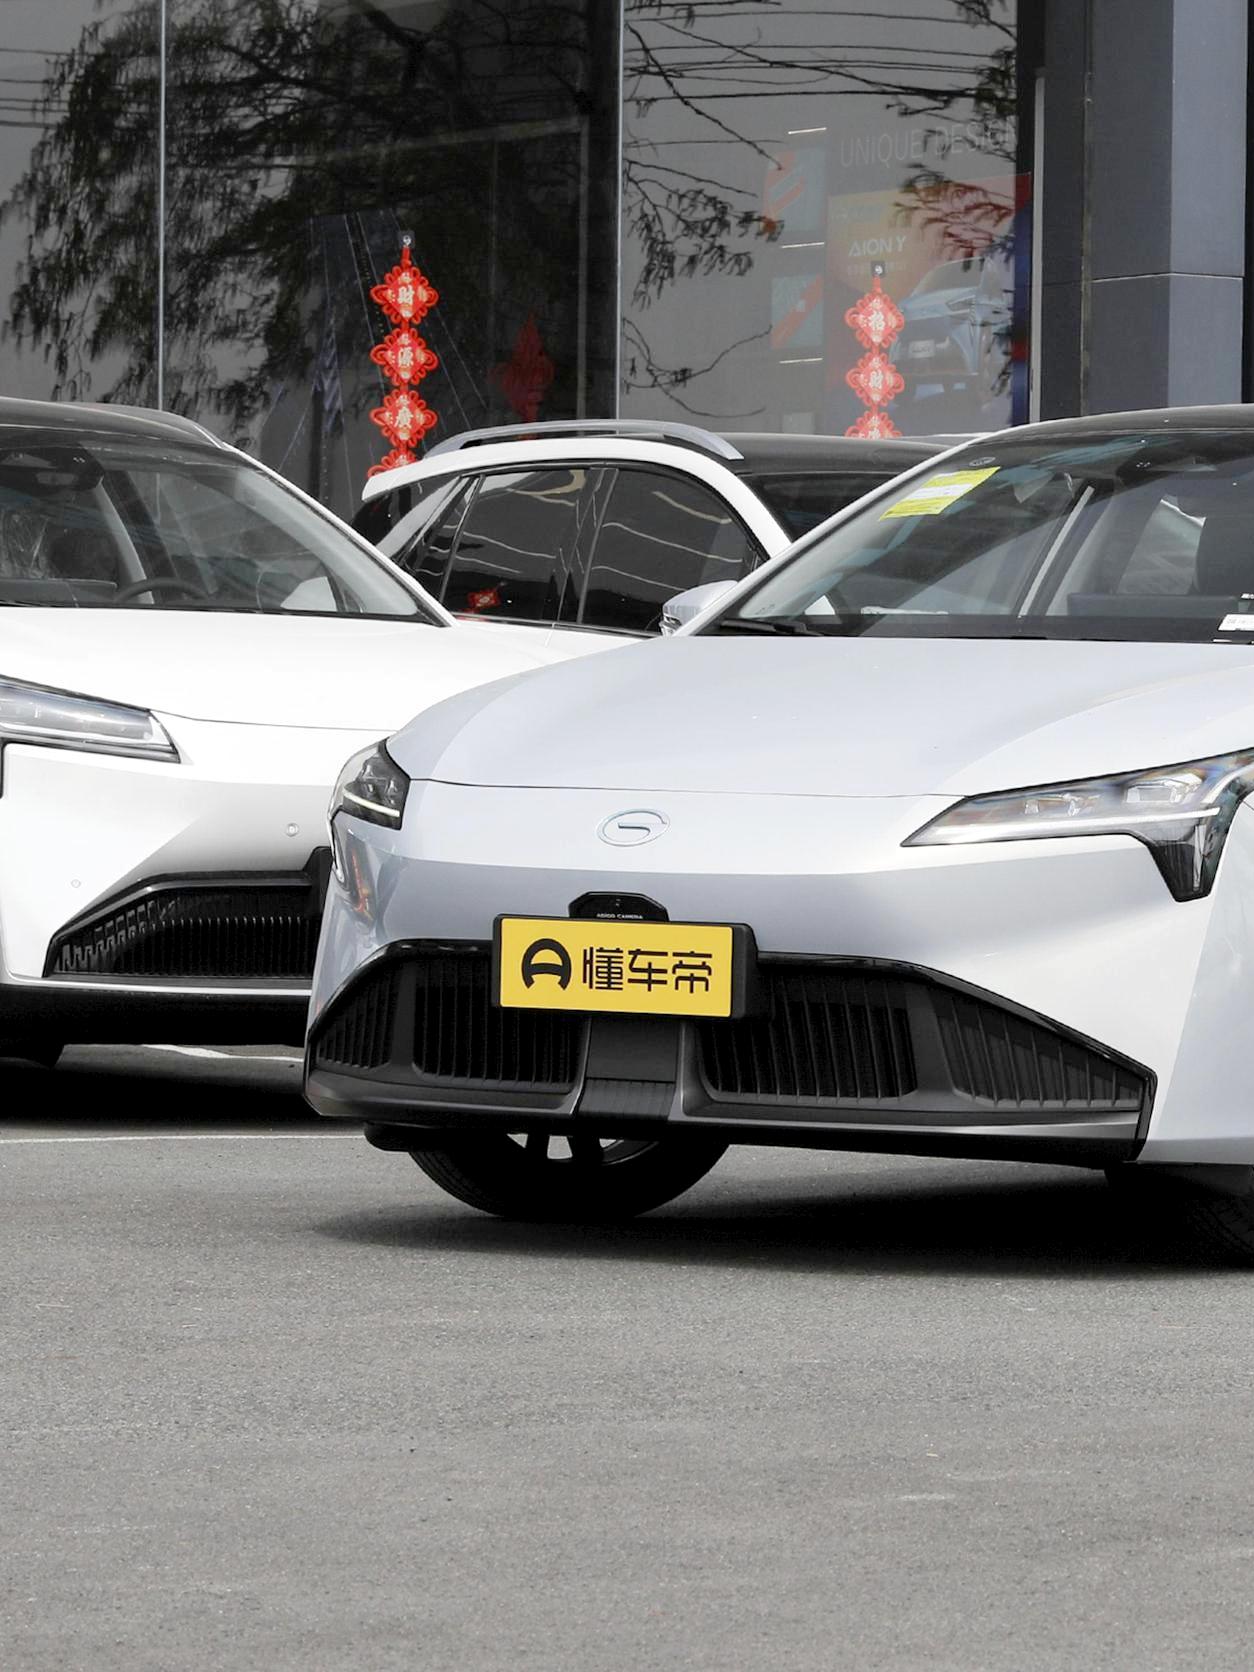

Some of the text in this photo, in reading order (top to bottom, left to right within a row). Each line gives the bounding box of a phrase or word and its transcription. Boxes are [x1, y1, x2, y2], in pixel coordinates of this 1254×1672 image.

[841, 129, 923, 168] UNIQUE
[848, 235, 908, 257] AION Y
[582, 946, 713, 994] 懂车帝
